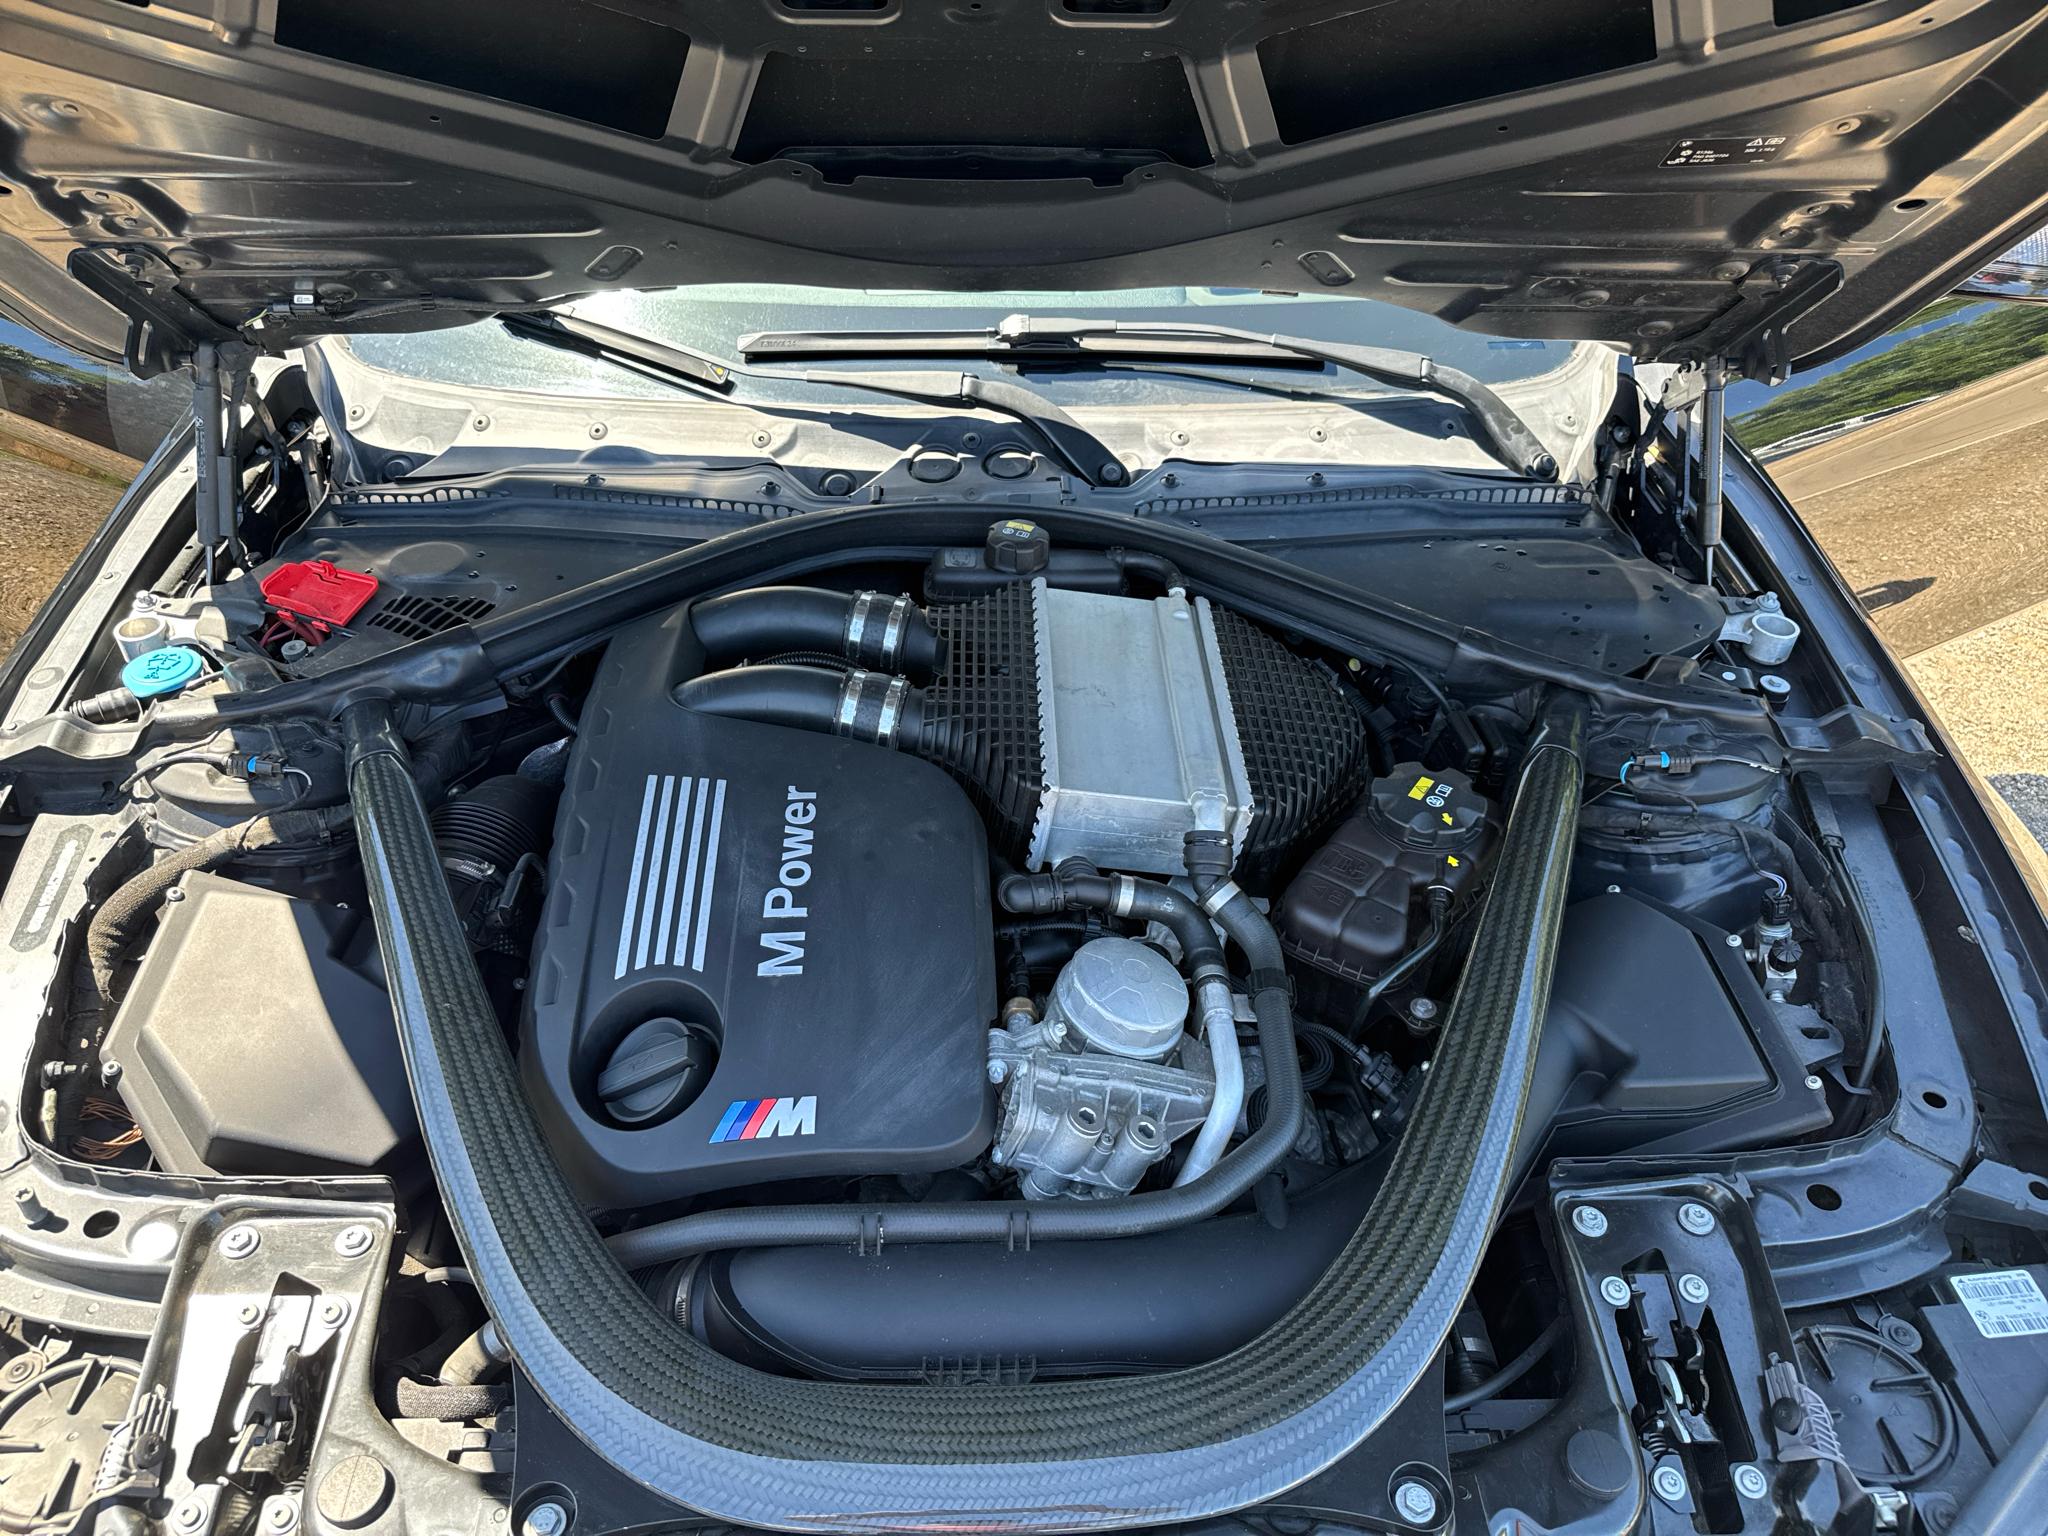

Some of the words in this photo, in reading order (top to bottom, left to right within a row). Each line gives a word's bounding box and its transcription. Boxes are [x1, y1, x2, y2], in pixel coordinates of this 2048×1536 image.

[763, 785, 817, 919] Power
[757, 931, 806, 977] M
[755, 1095, 817, 1139] M
